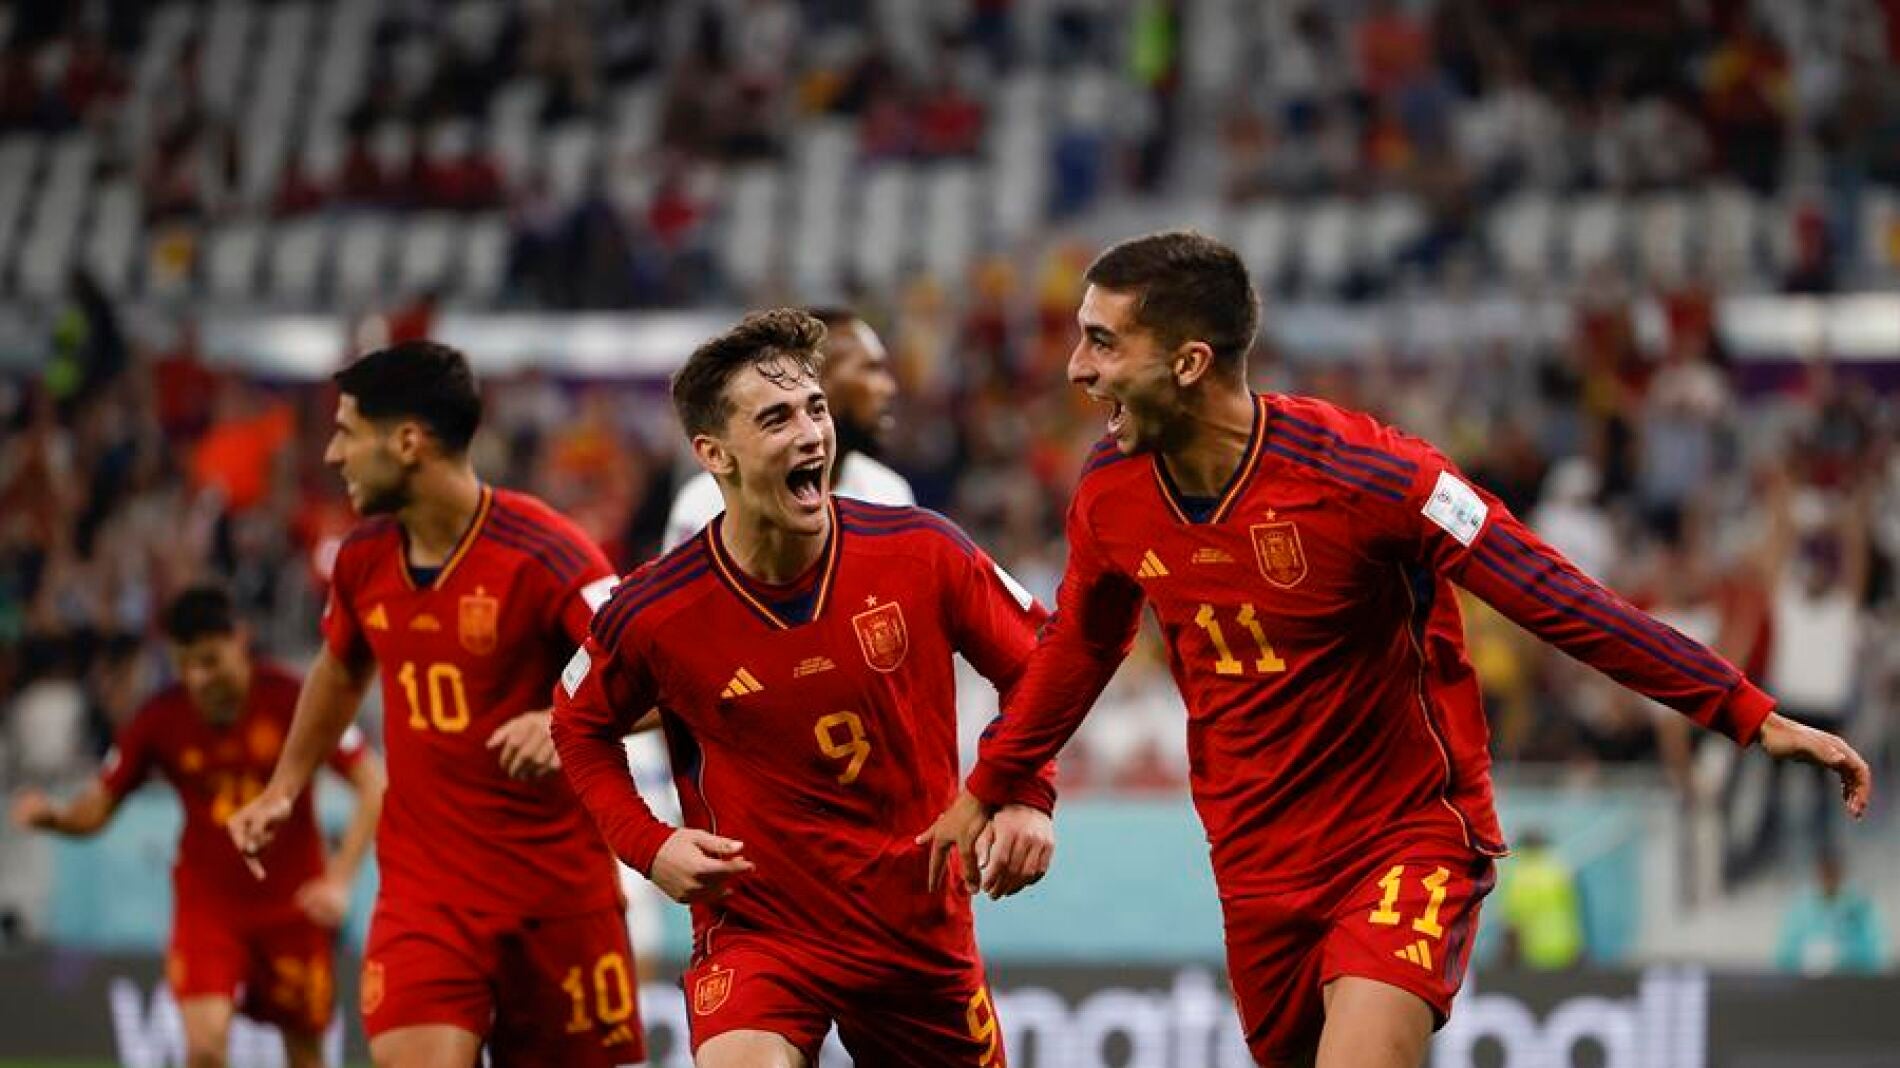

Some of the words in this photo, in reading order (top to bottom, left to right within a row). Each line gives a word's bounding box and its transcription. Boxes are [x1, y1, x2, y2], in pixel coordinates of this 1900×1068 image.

[1194, 603, 1286, 674] 11
[399, 662, 470, 732] 10
[815, 710, 870, 783] 9
[1367, 865, 1450, 938] 11
[561, 953, 634, 1033] 10
[966, 987, 998, 1067] 9
